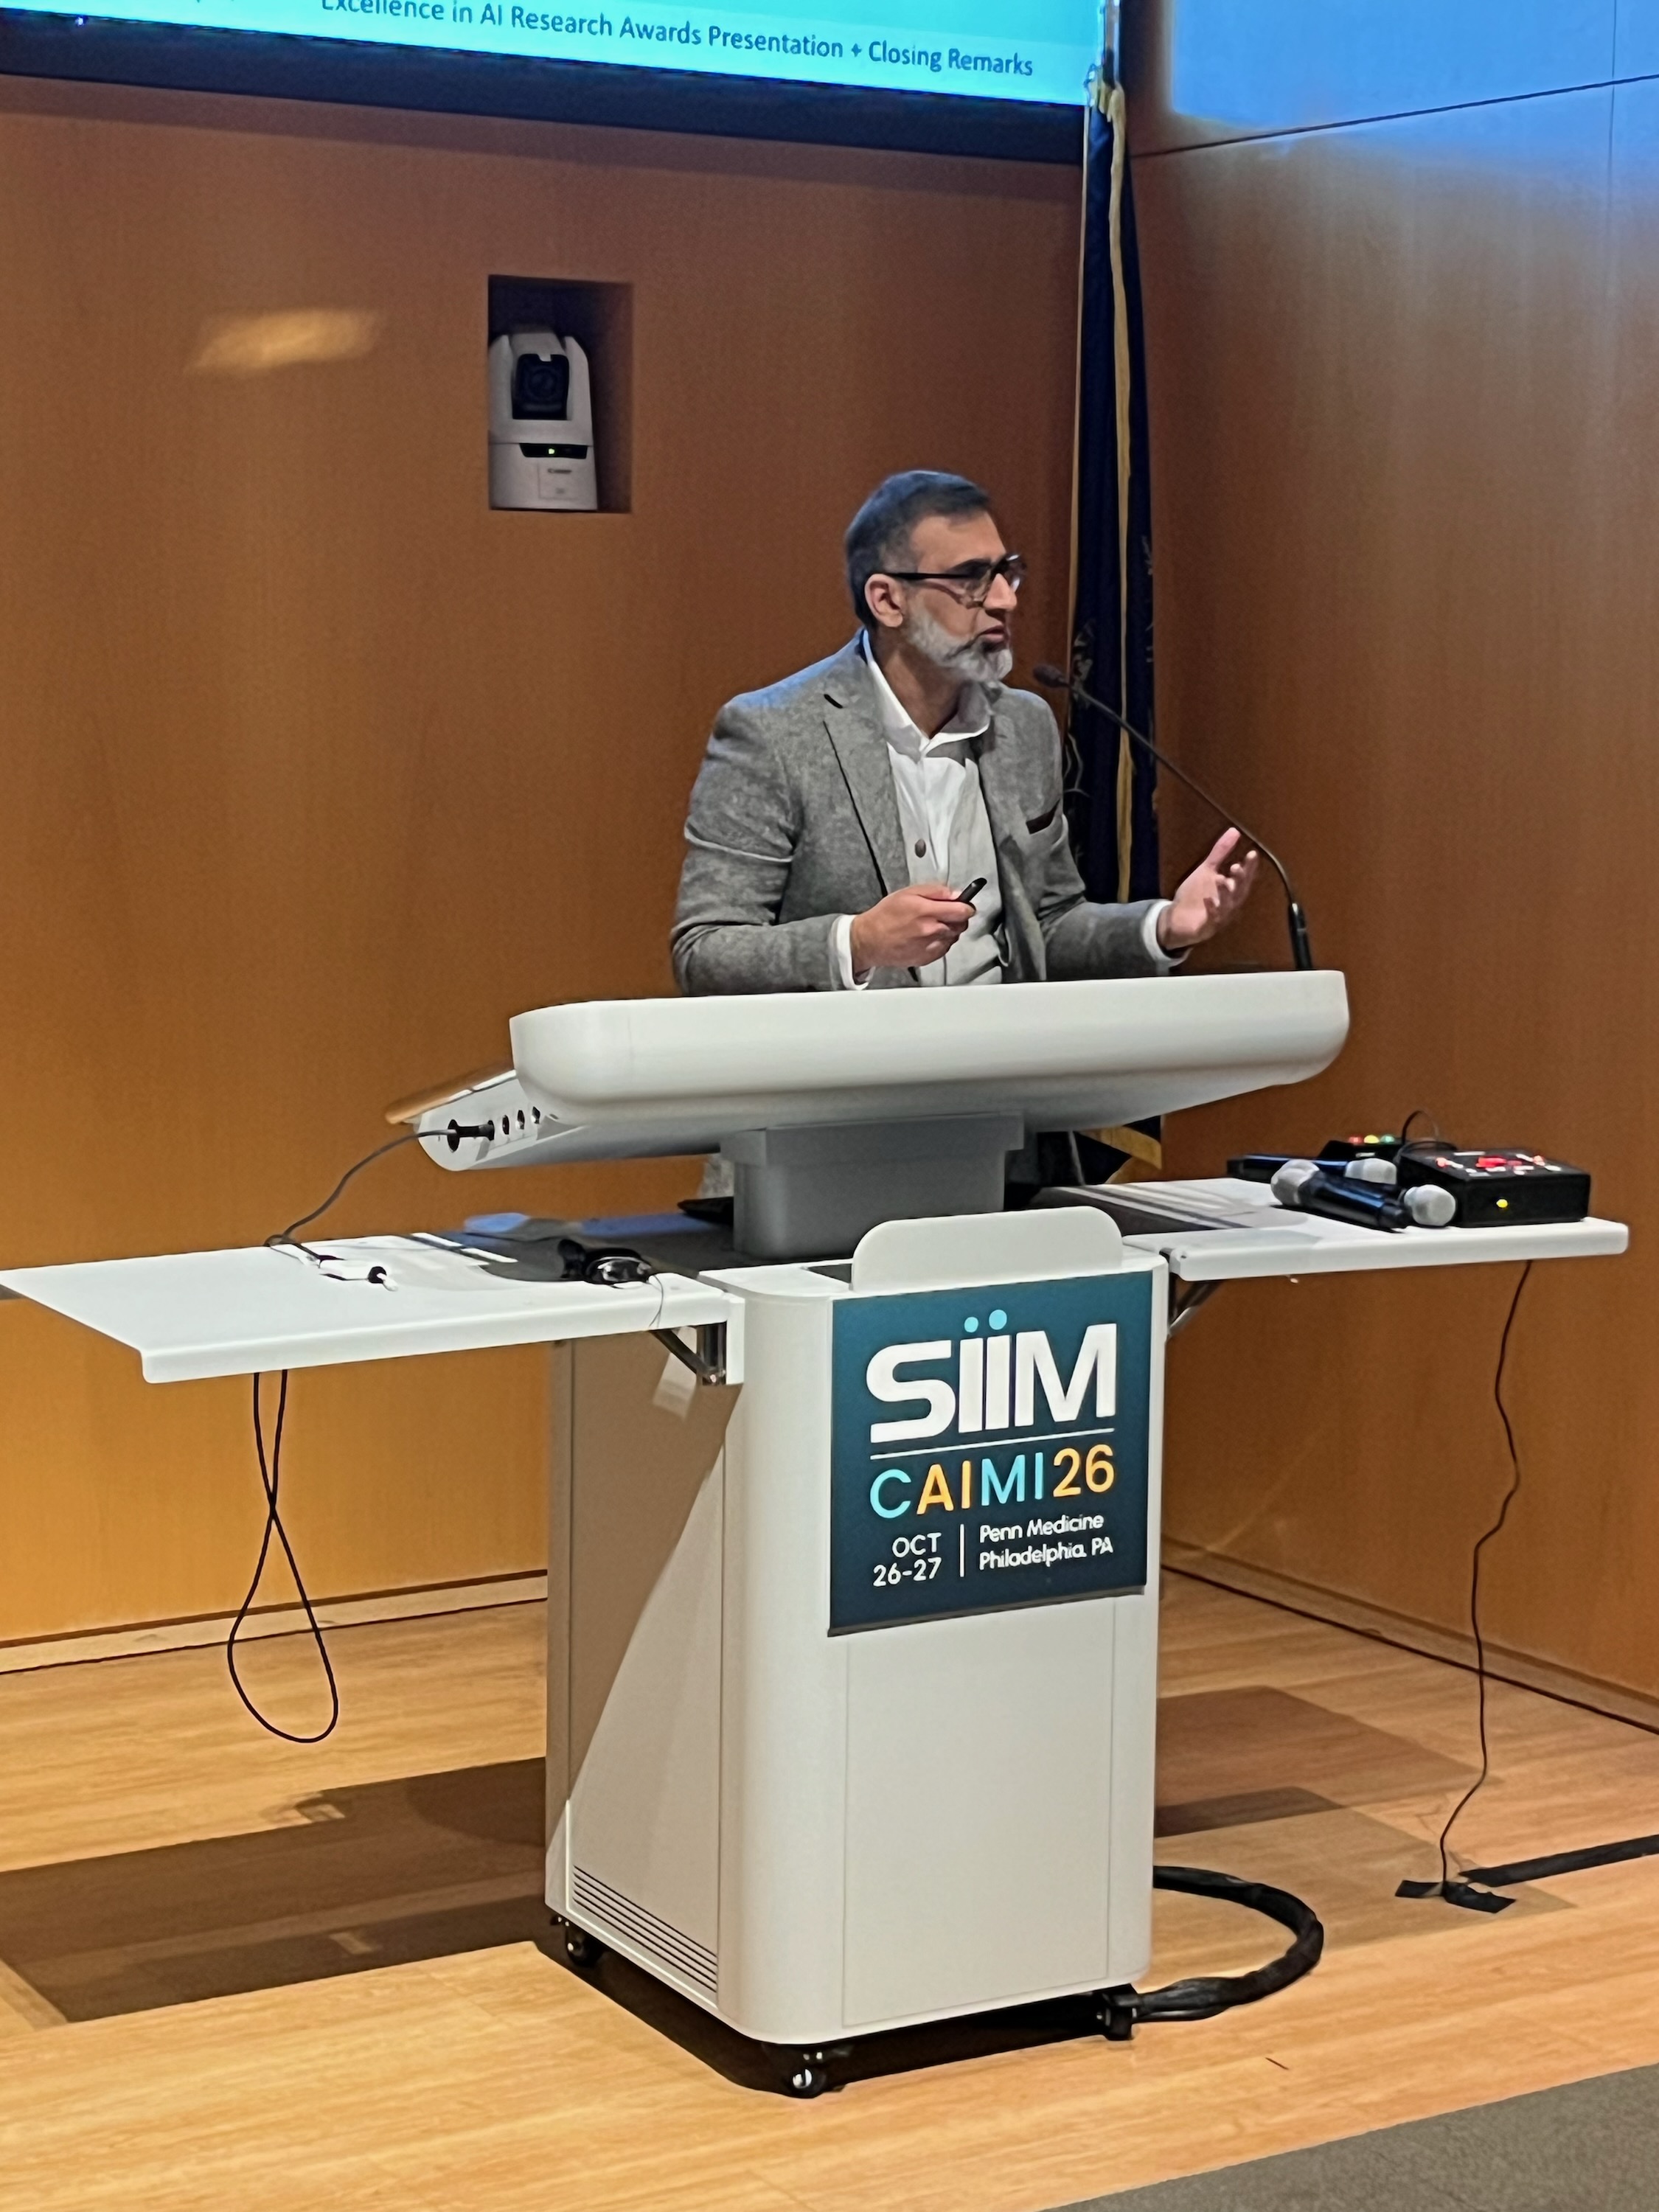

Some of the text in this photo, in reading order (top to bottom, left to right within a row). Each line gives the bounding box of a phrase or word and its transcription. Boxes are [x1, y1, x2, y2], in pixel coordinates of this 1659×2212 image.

[452, 1, 473, 24] in
[480, 3, 502, 26] AI
[511, 5, 612, 36] Research
[619, 16, 701, 45] Awards
[709, 25, 844, 58] Presentation
[869, 40, 942, 72] Closing
[948, 48, 1033, 76] Remarks
[979, 1514, 1105, 1543] Penn Medicine
[892, 1532, 942, 1558] OCT
[979, 1536, 1114, 1571] Philadelphia PA
[873, 1557, 942, 1587] 26-27
